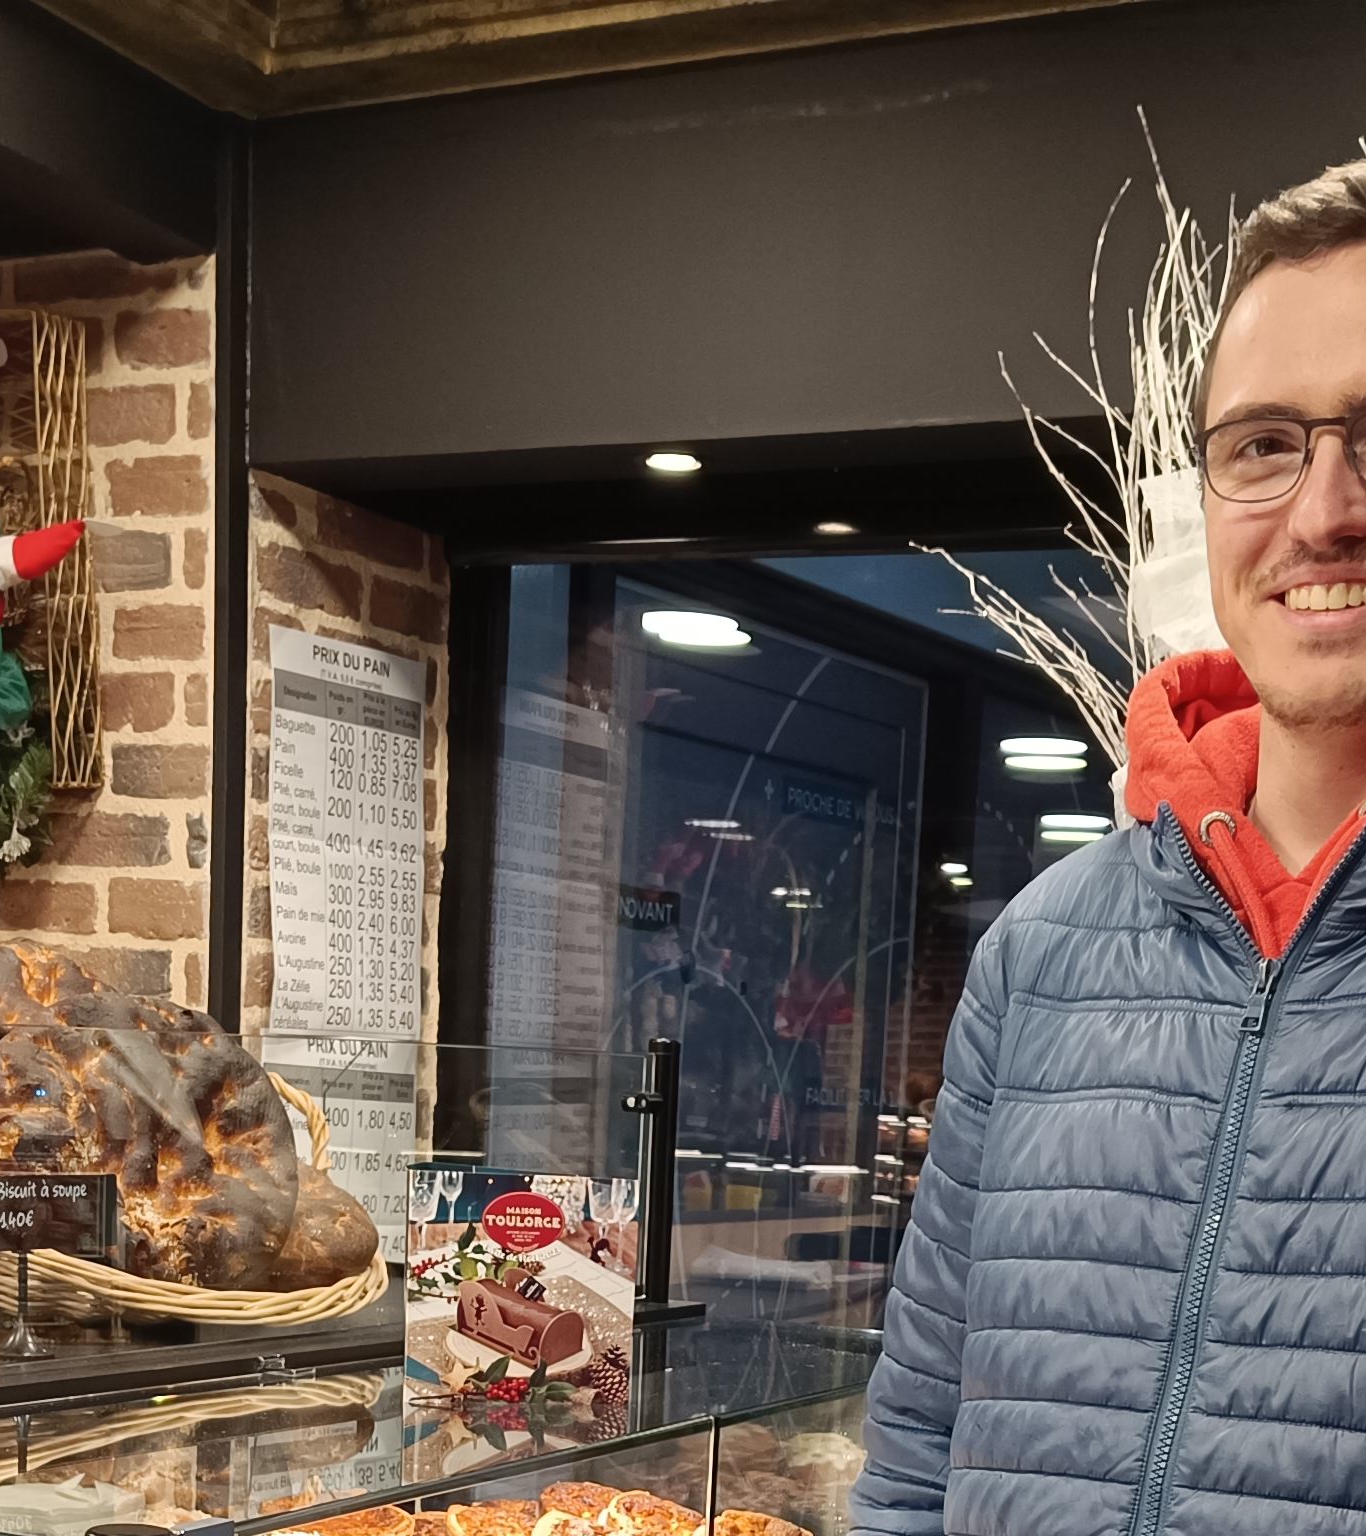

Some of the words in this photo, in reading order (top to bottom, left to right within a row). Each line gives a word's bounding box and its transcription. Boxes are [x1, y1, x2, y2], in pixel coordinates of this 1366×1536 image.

[313, 645, 339, 670] PRIX
[343, 652, 360, 670] DU
[364, 657, 390, 678] PAIN
[275, 714, 316, 735] Baguette
[330, 722, 355, 746] 200
[275, 738, 296, 755] Pain
[329, 746, 354, 769] 400
[274, 760, 304, 778] Ficelle
[331, 769, 353, 790] 120
[298, 806, 321, 819] boule
[327, 796, 352, 819] 200
[358, 802, 385, 825] 1,10
[391, 808, 417, 830] 5,50
[298, 842, 321, 854] boule
[326, 833, 350, 854] 400
[357, 837, 383, 859] 1,45
[389, 842, 417, 864] 3,62
[297, 861, 321, 875] boule
[329, 863, 353, 880] 1000
[329, 884, 353, 906] 300
[276, 905, 296, 919] Pain
[298, 908, 308, 921] de
[311, 911, 325, 923] mie
[329, 909, 352, 930] 400
[277, 930, 306, 946] Avoine
[329, 933, 352, 953] 400
[329, 956, 352, 976] 250
[278, 979, 289, 992] La
[329, 979, 352, 999] 250
[327, 1006, 351, 1026] 250
[357, 1110, 385, 1130] 1,80
[389, 1112, 411, 1132] 4,50
[329, 1151, 347, 1171] 00
[354, 1152, 381, 1172] 1,85
[40, 1179, 50, 1198] à
[52, 1183, 87, 1202] soupe
[485, 1214, 561, 1229] TOULORGE
[505, 1206, 541, 1215] MAISON
